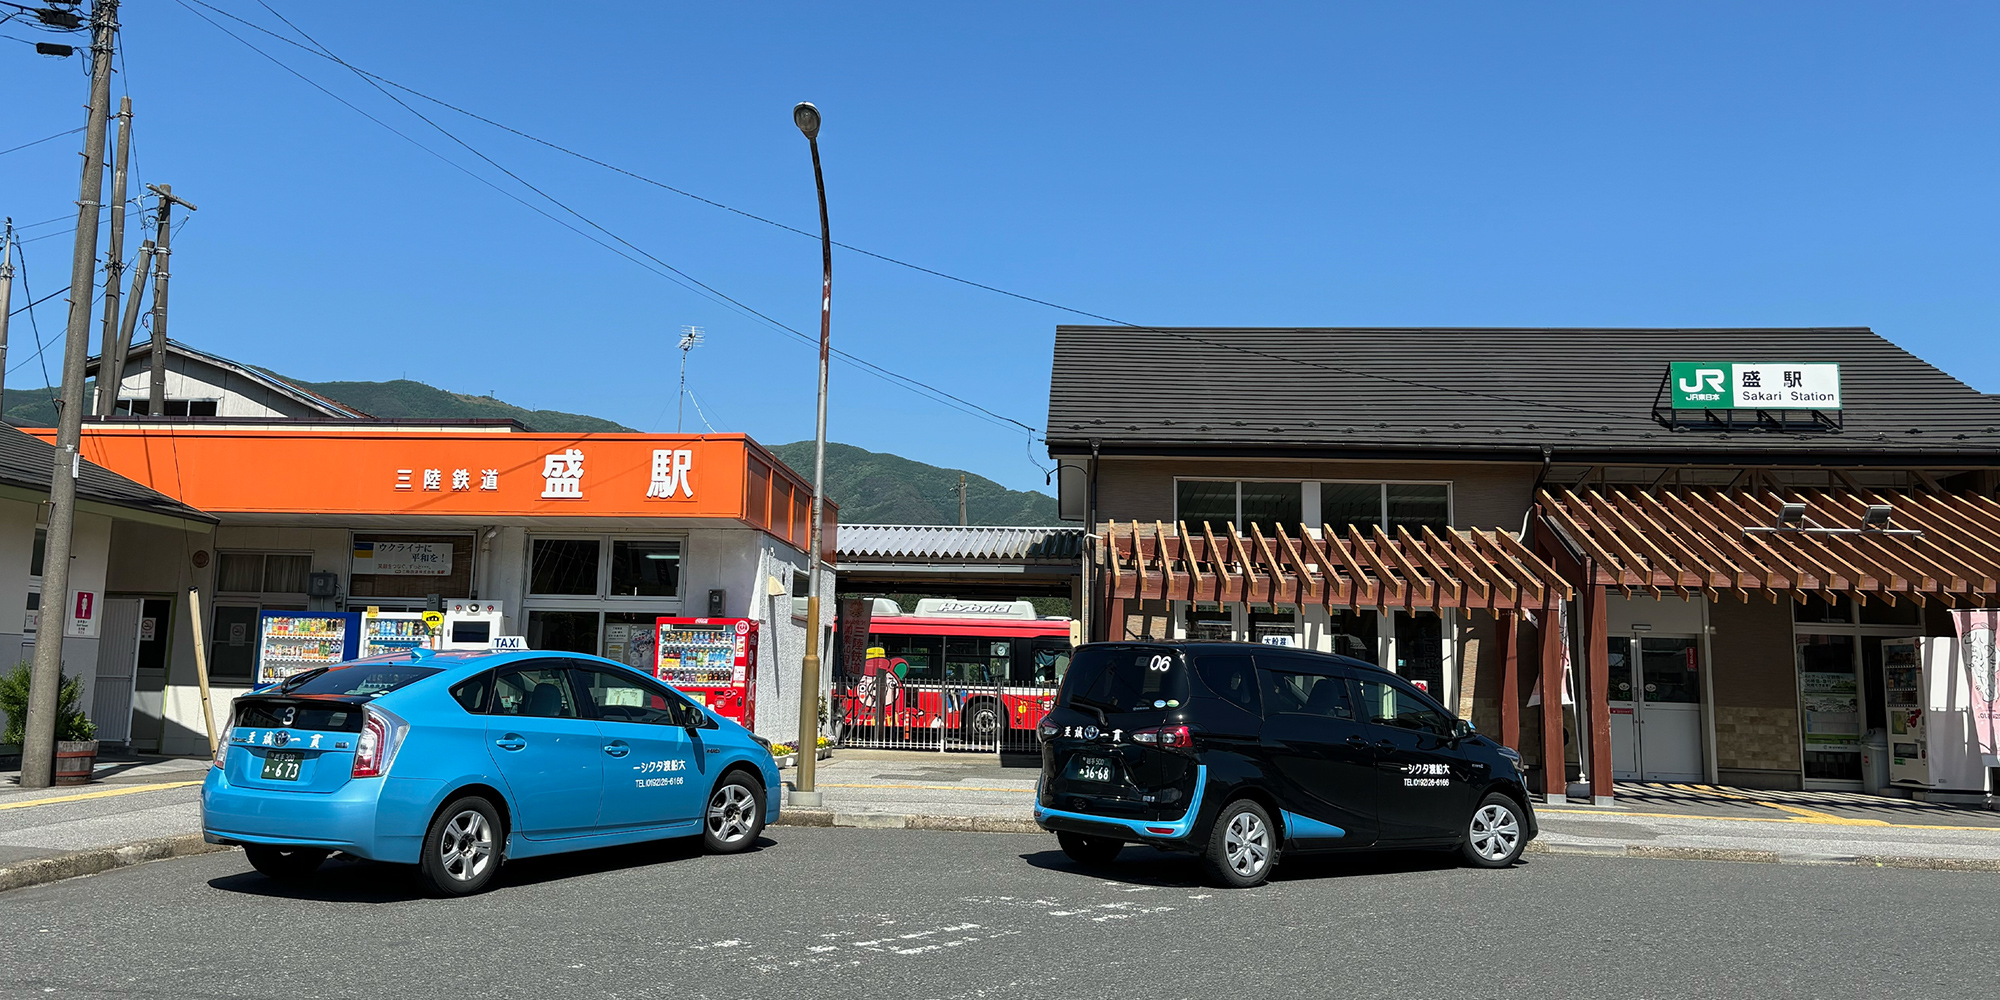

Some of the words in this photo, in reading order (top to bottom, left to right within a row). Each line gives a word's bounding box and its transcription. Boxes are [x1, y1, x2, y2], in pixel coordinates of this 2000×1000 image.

[1679, 368, 1726, 393] JR
[1685, 393, 1720, 401] JR東日本
[1742, 391, 1782, 401] Sakari
[1790, 391, 1835, 402] Station
[395, 468, 499, 491] 三陸鉄道
[379, 543, 433, 552] ウクライナに
[937, 602, 1013, 614] Hybrid
[494, 637, 520, 648] TAXI
[1150, 655, 1172, 672] 06
[282, 706, 296, 726] 3
[1084, 765, 1110, 780] 36-68
